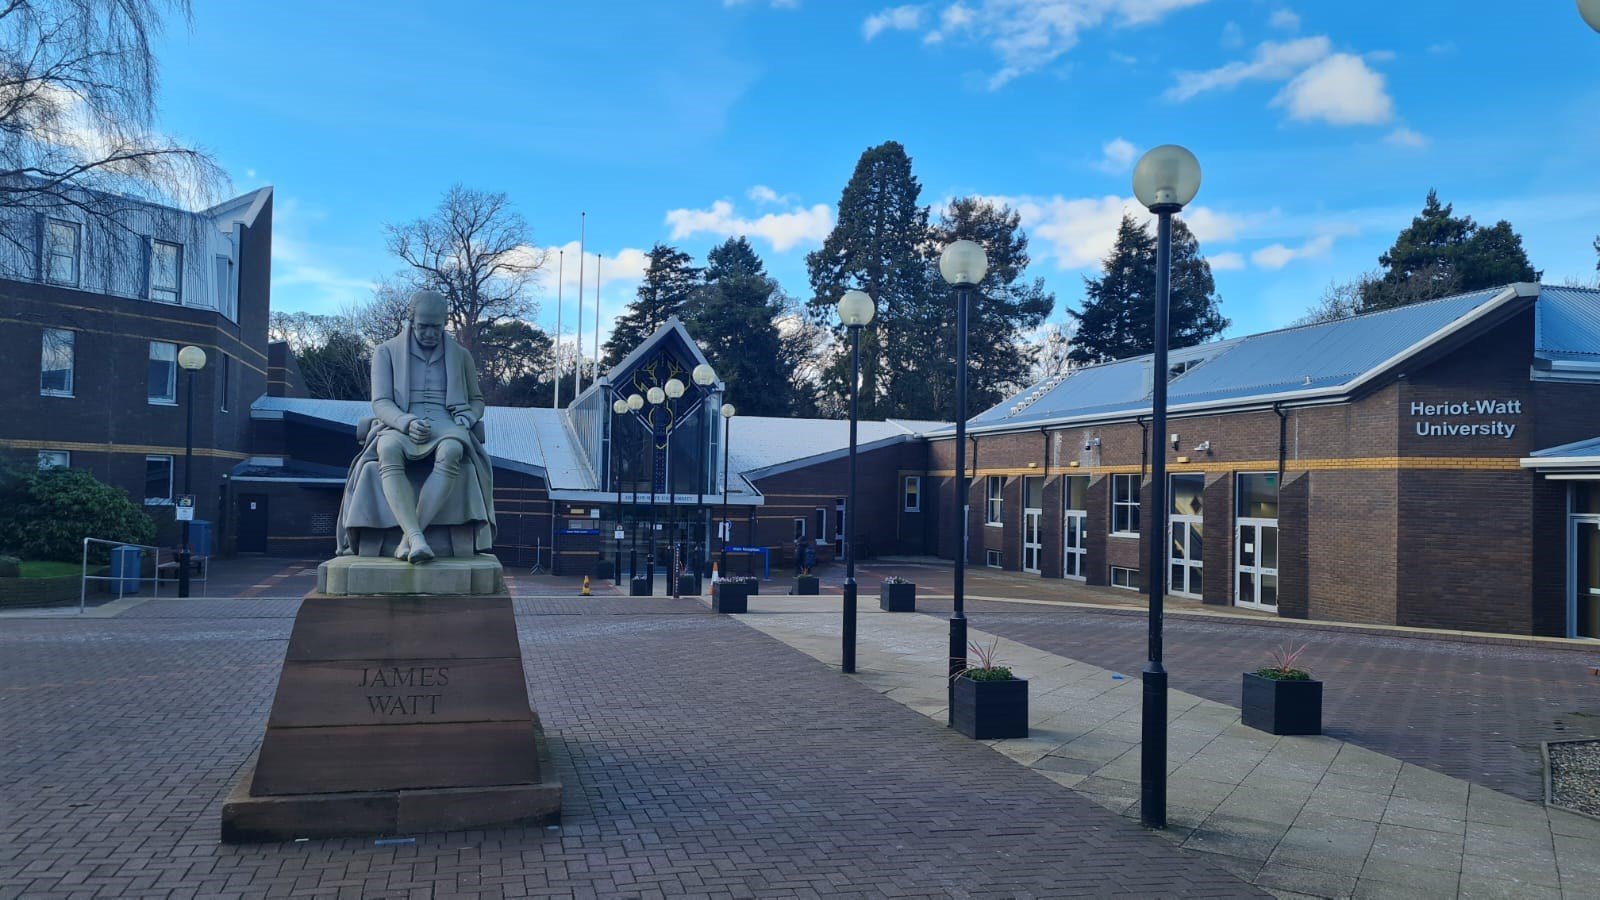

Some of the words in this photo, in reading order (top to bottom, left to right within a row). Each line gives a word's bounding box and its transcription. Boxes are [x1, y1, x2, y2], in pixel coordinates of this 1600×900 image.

[1410, 400, 1521, 416] Heriot-Watt
[1416, 421, 1516, 439] University
[358, 667, 449, 687] JAMES
[366, 694, 443, 715] WATT
